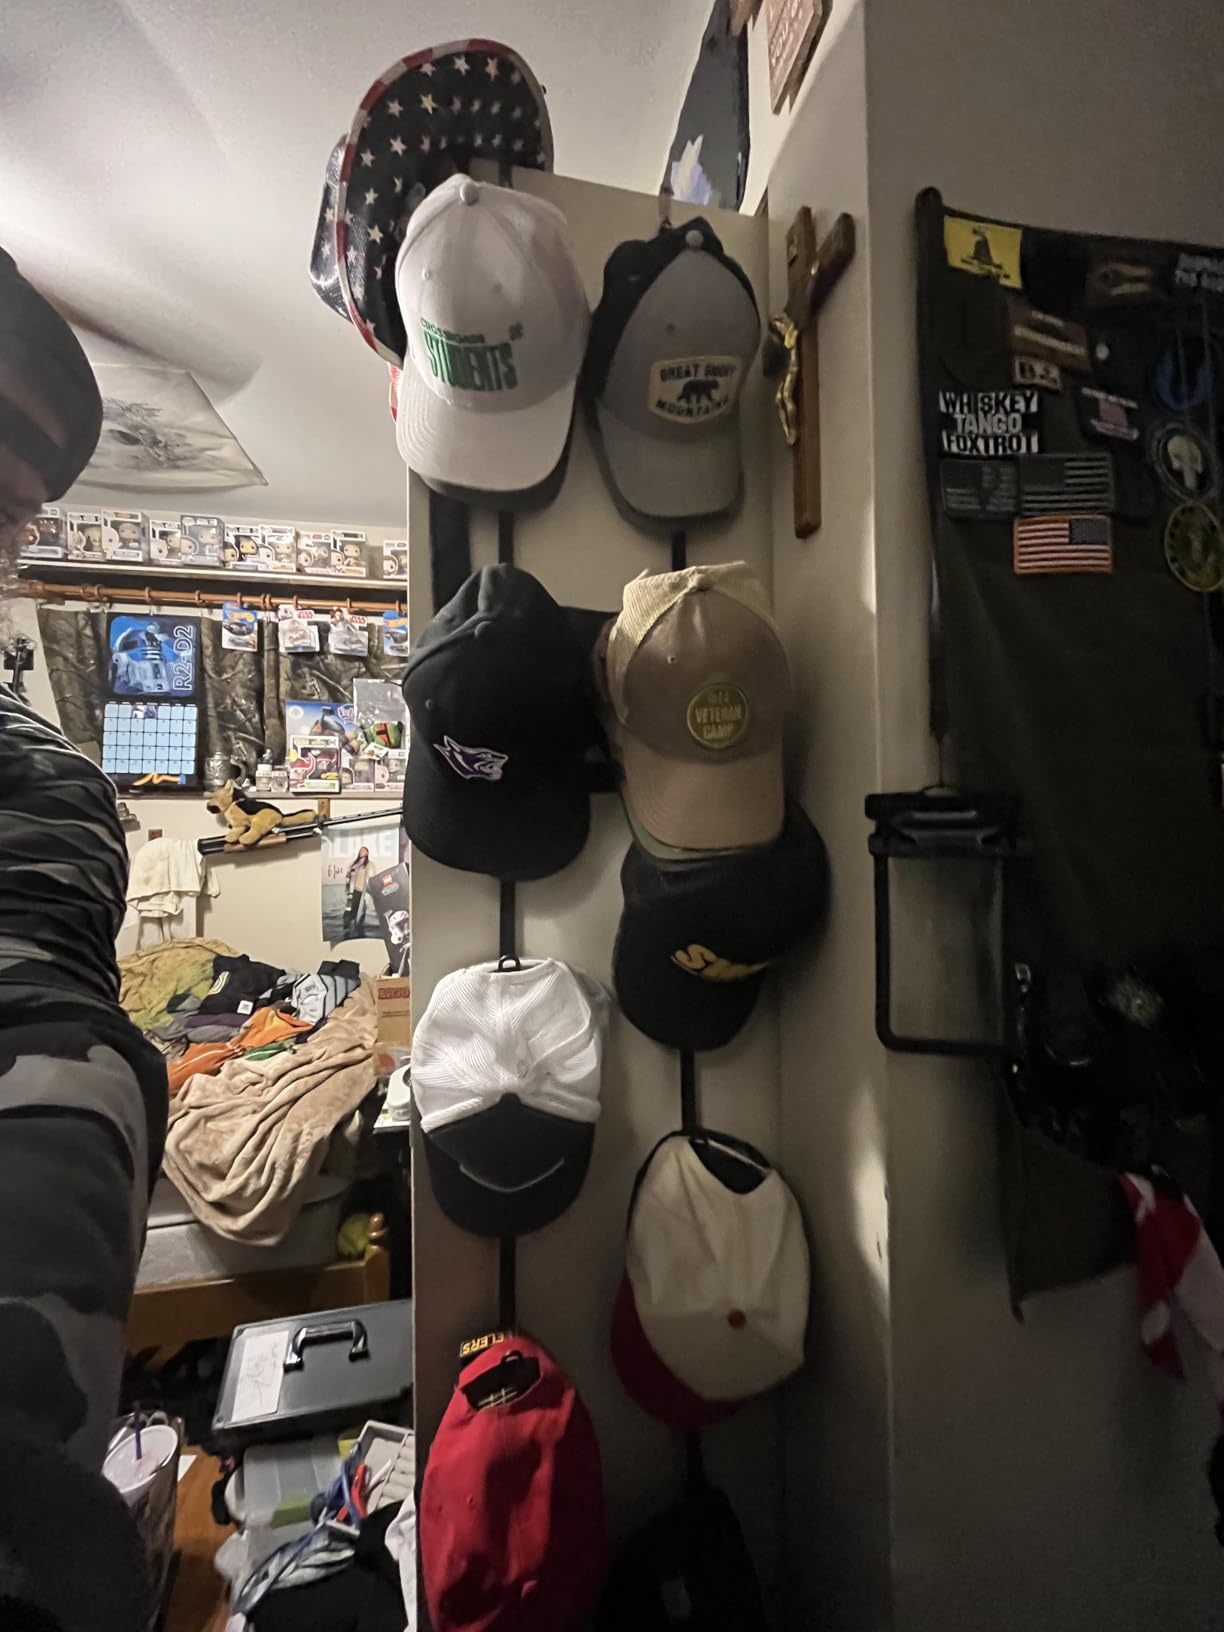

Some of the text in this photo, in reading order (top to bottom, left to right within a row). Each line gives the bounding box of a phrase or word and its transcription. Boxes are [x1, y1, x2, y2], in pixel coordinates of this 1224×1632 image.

[940, 391, 1039, 413] WHISKEY
[954, 412, 1023, 434] TANGO
[942, 431, 1039, 453] FOXTROT
[172, 624, 194, 692] R2-D2
